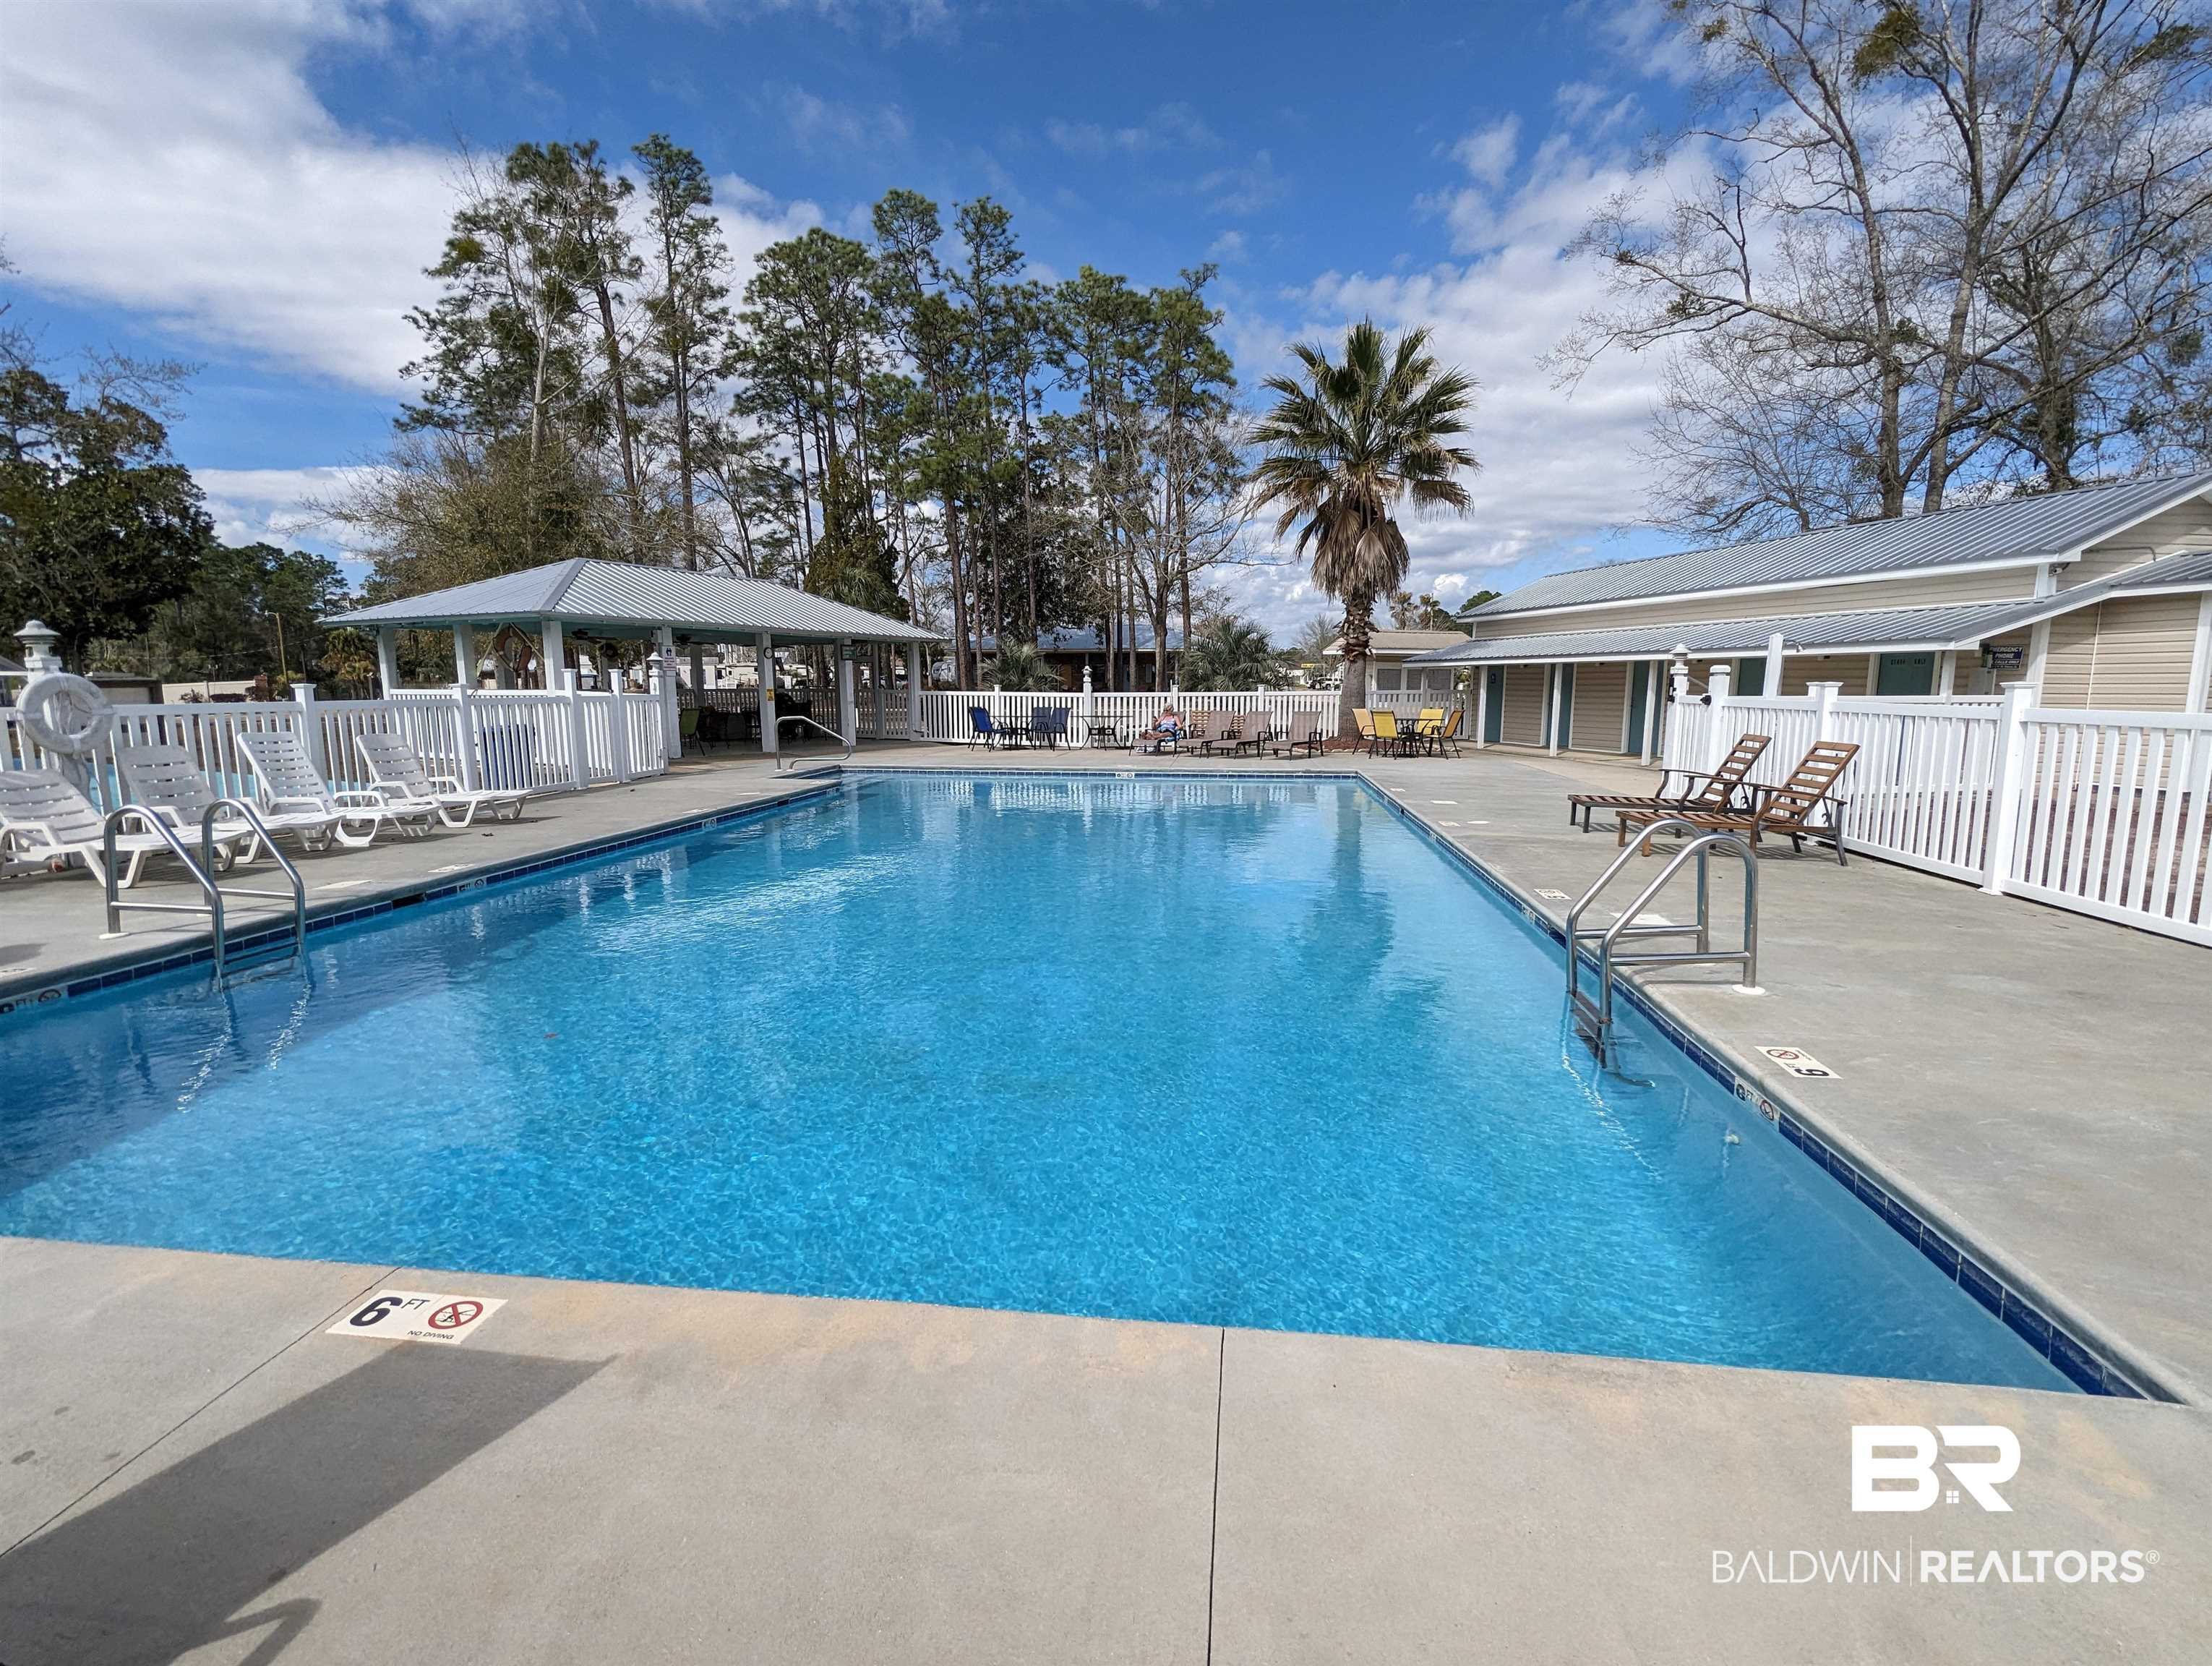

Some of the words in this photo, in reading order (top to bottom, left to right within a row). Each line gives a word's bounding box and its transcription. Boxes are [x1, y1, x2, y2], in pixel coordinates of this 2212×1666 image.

[350, 1297, 403, 1327] 6
[400, 1299, 430, 1310] FT
[423, 1331, 455, 1340] DIVING
